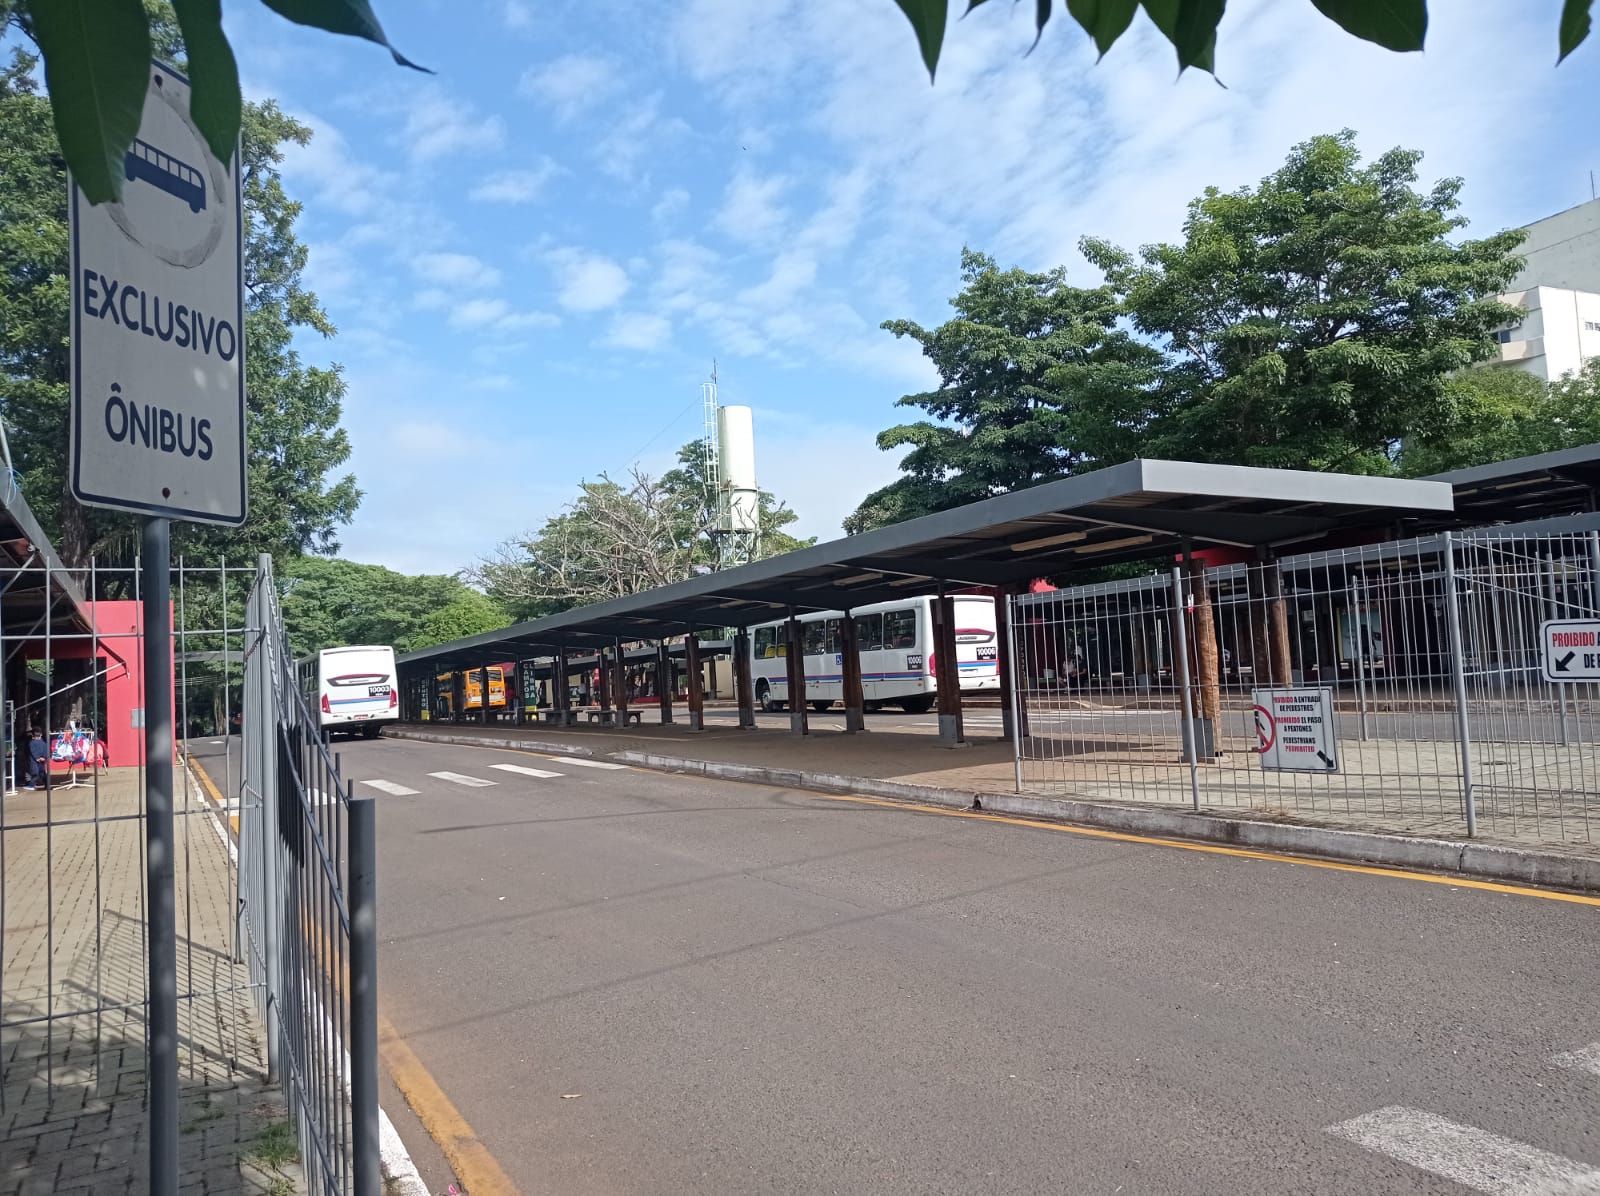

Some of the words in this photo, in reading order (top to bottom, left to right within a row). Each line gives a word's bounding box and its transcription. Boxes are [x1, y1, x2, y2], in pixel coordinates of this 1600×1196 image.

[83, 269, 236, 362] EXCLUSIVO
[105, 383, 213, 461] ÔNIBUS
[1552, 632, 1595, 647] PROIBIDO
[1584, 654, 1596, 668] DE
